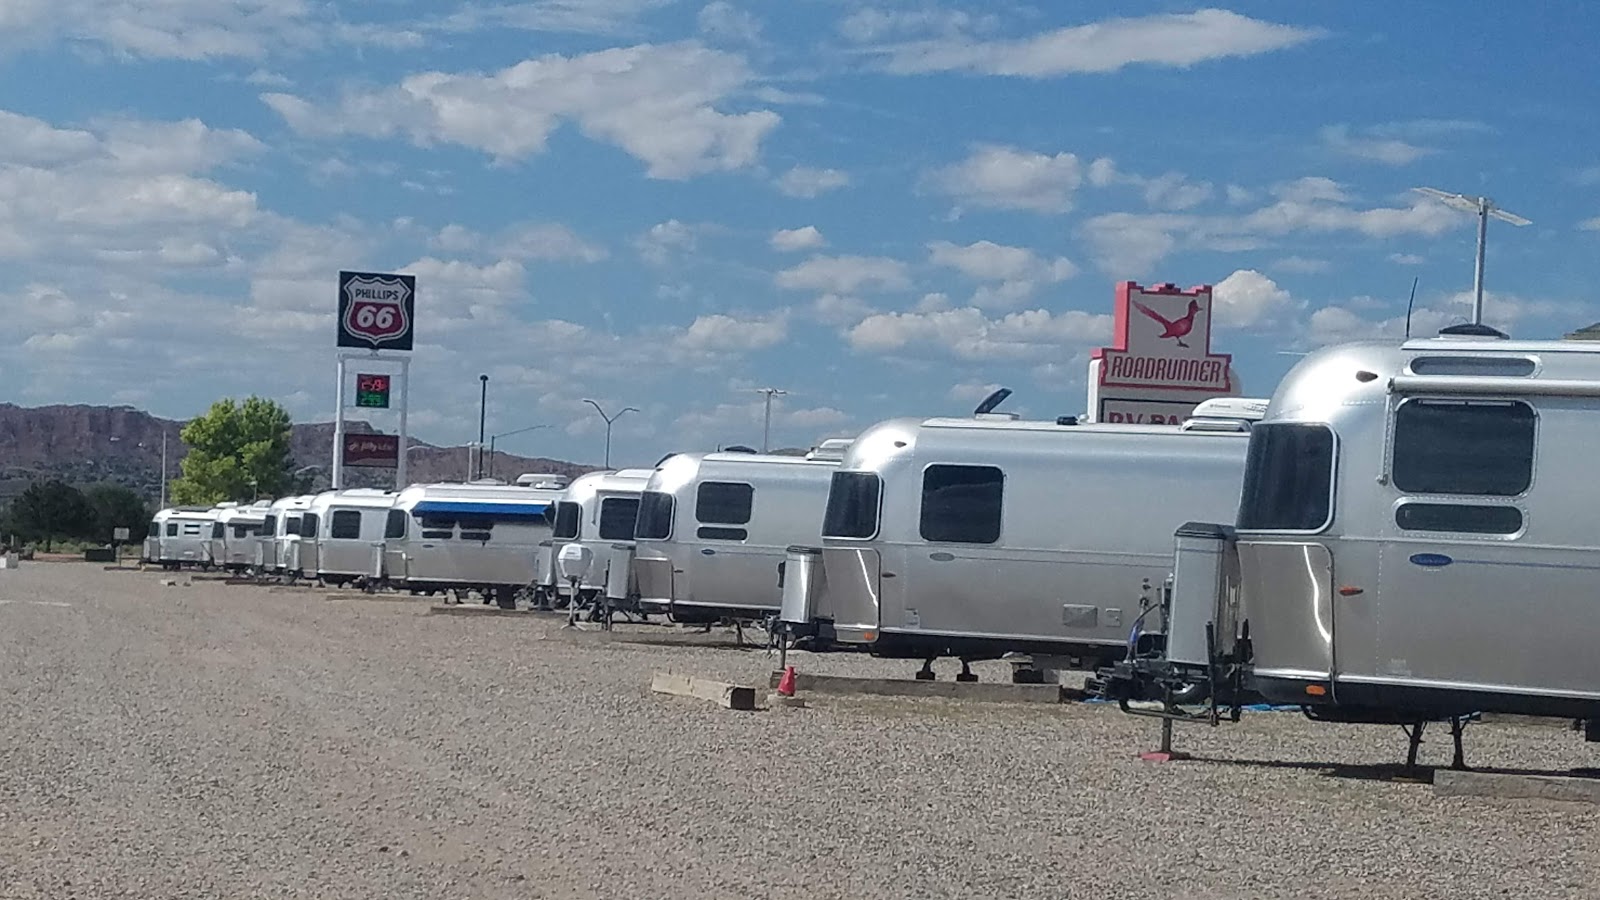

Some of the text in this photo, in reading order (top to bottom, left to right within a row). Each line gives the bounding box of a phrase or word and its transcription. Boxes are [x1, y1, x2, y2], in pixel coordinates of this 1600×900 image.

[355, 288, 399, 300] PHILLIPS
[356, 305, 396, 329] 66
[1111, 356, 1221, 383] ROADRUNNER
